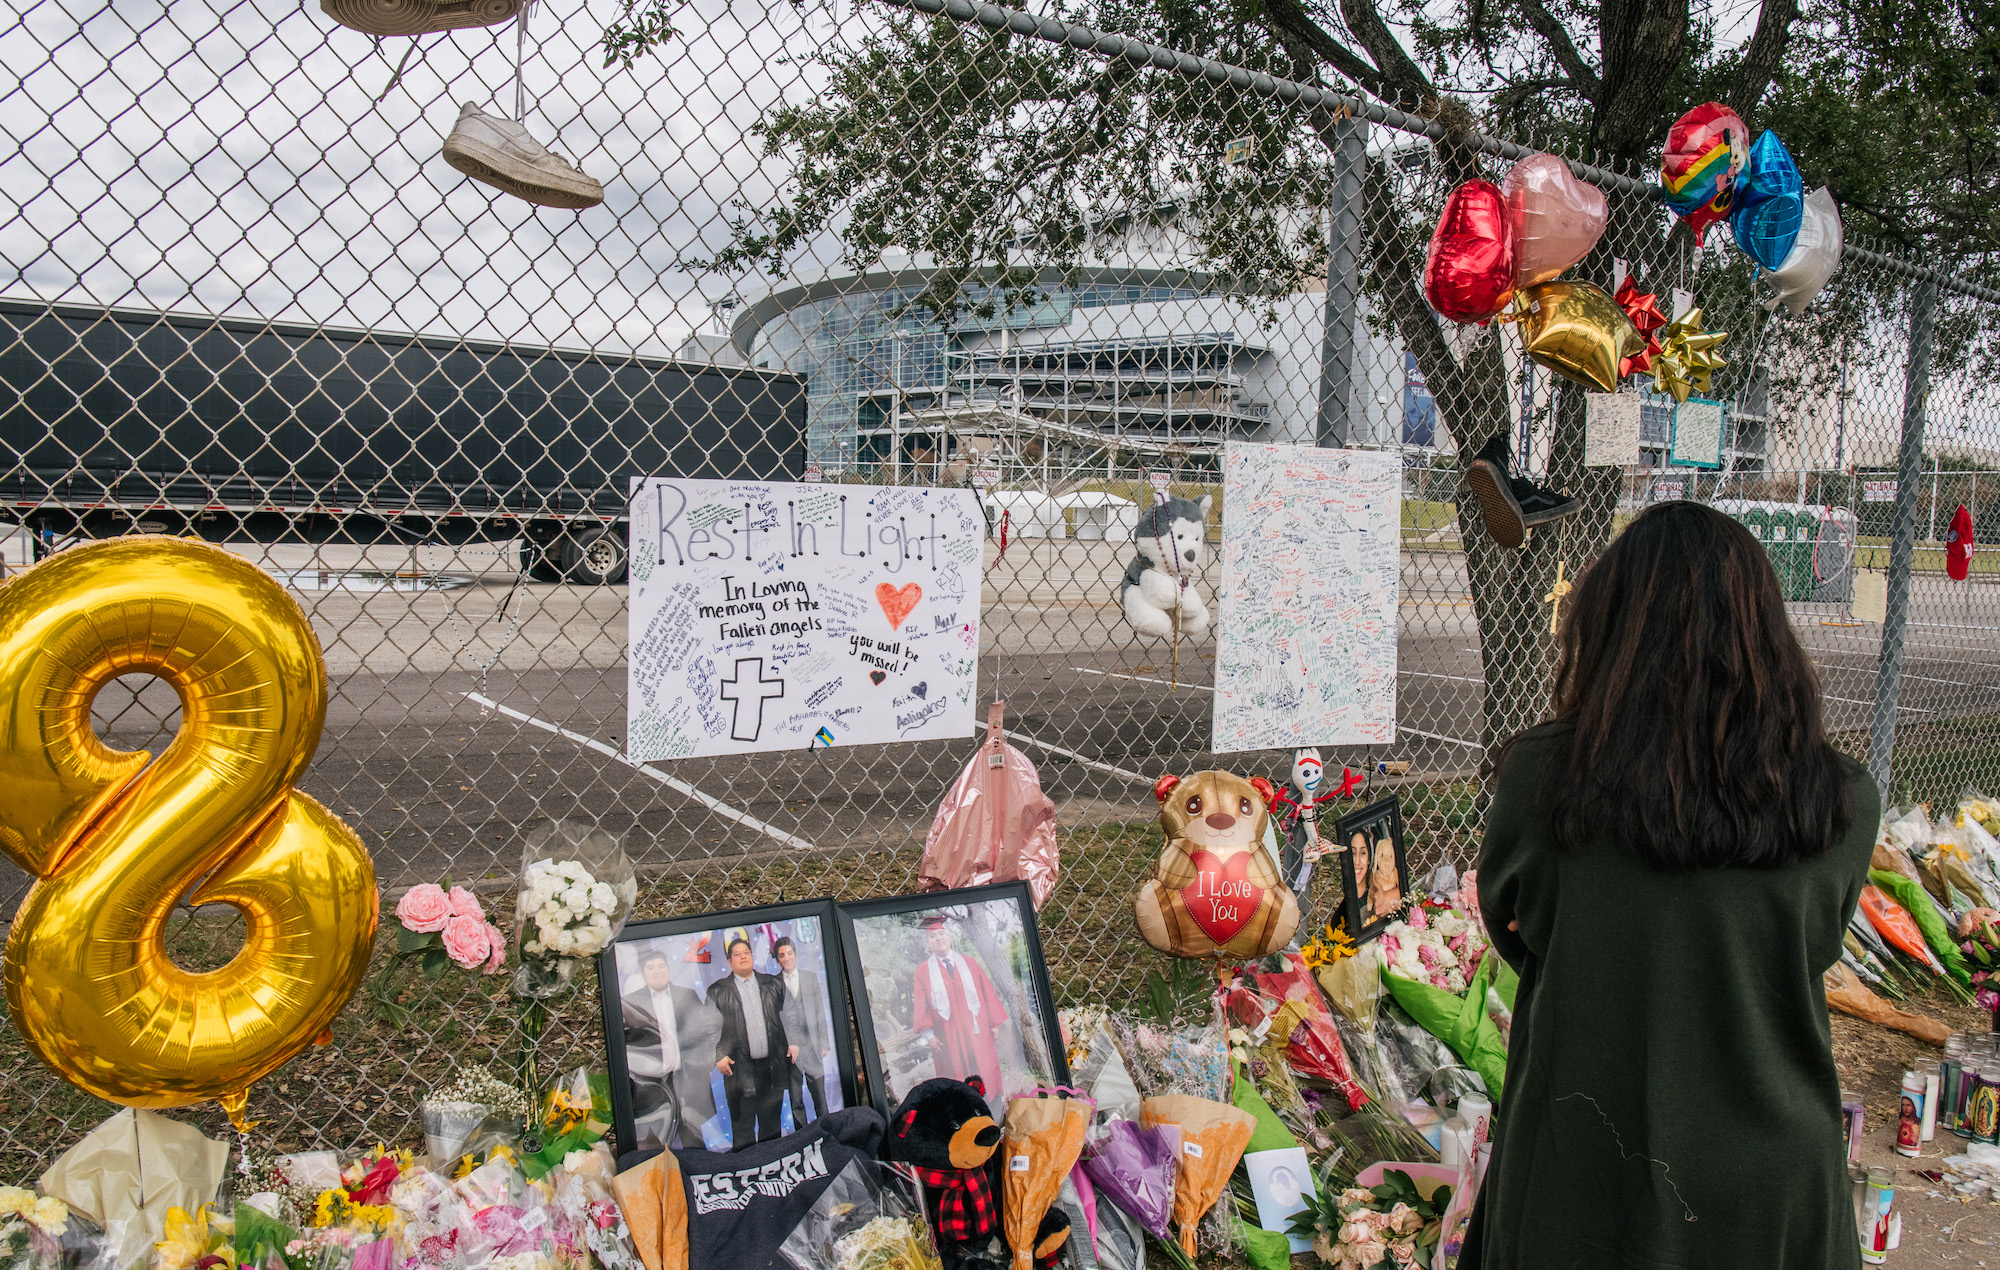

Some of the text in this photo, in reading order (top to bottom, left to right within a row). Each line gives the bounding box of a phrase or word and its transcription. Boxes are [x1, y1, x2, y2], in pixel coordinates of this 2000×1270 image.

[656, 483, 947, 574] Rest In Light
[721, 576, 746, 601] In
[752, 578, 810, 603] Loving
[700, 597, 820, 621] memory of the
[720, 616, 823, 641] Fallen angels
[848, 635, 919, 663] you will be
[1197, 871, 1252, 898] I Love
[1208, 898, 1239, 923] You
